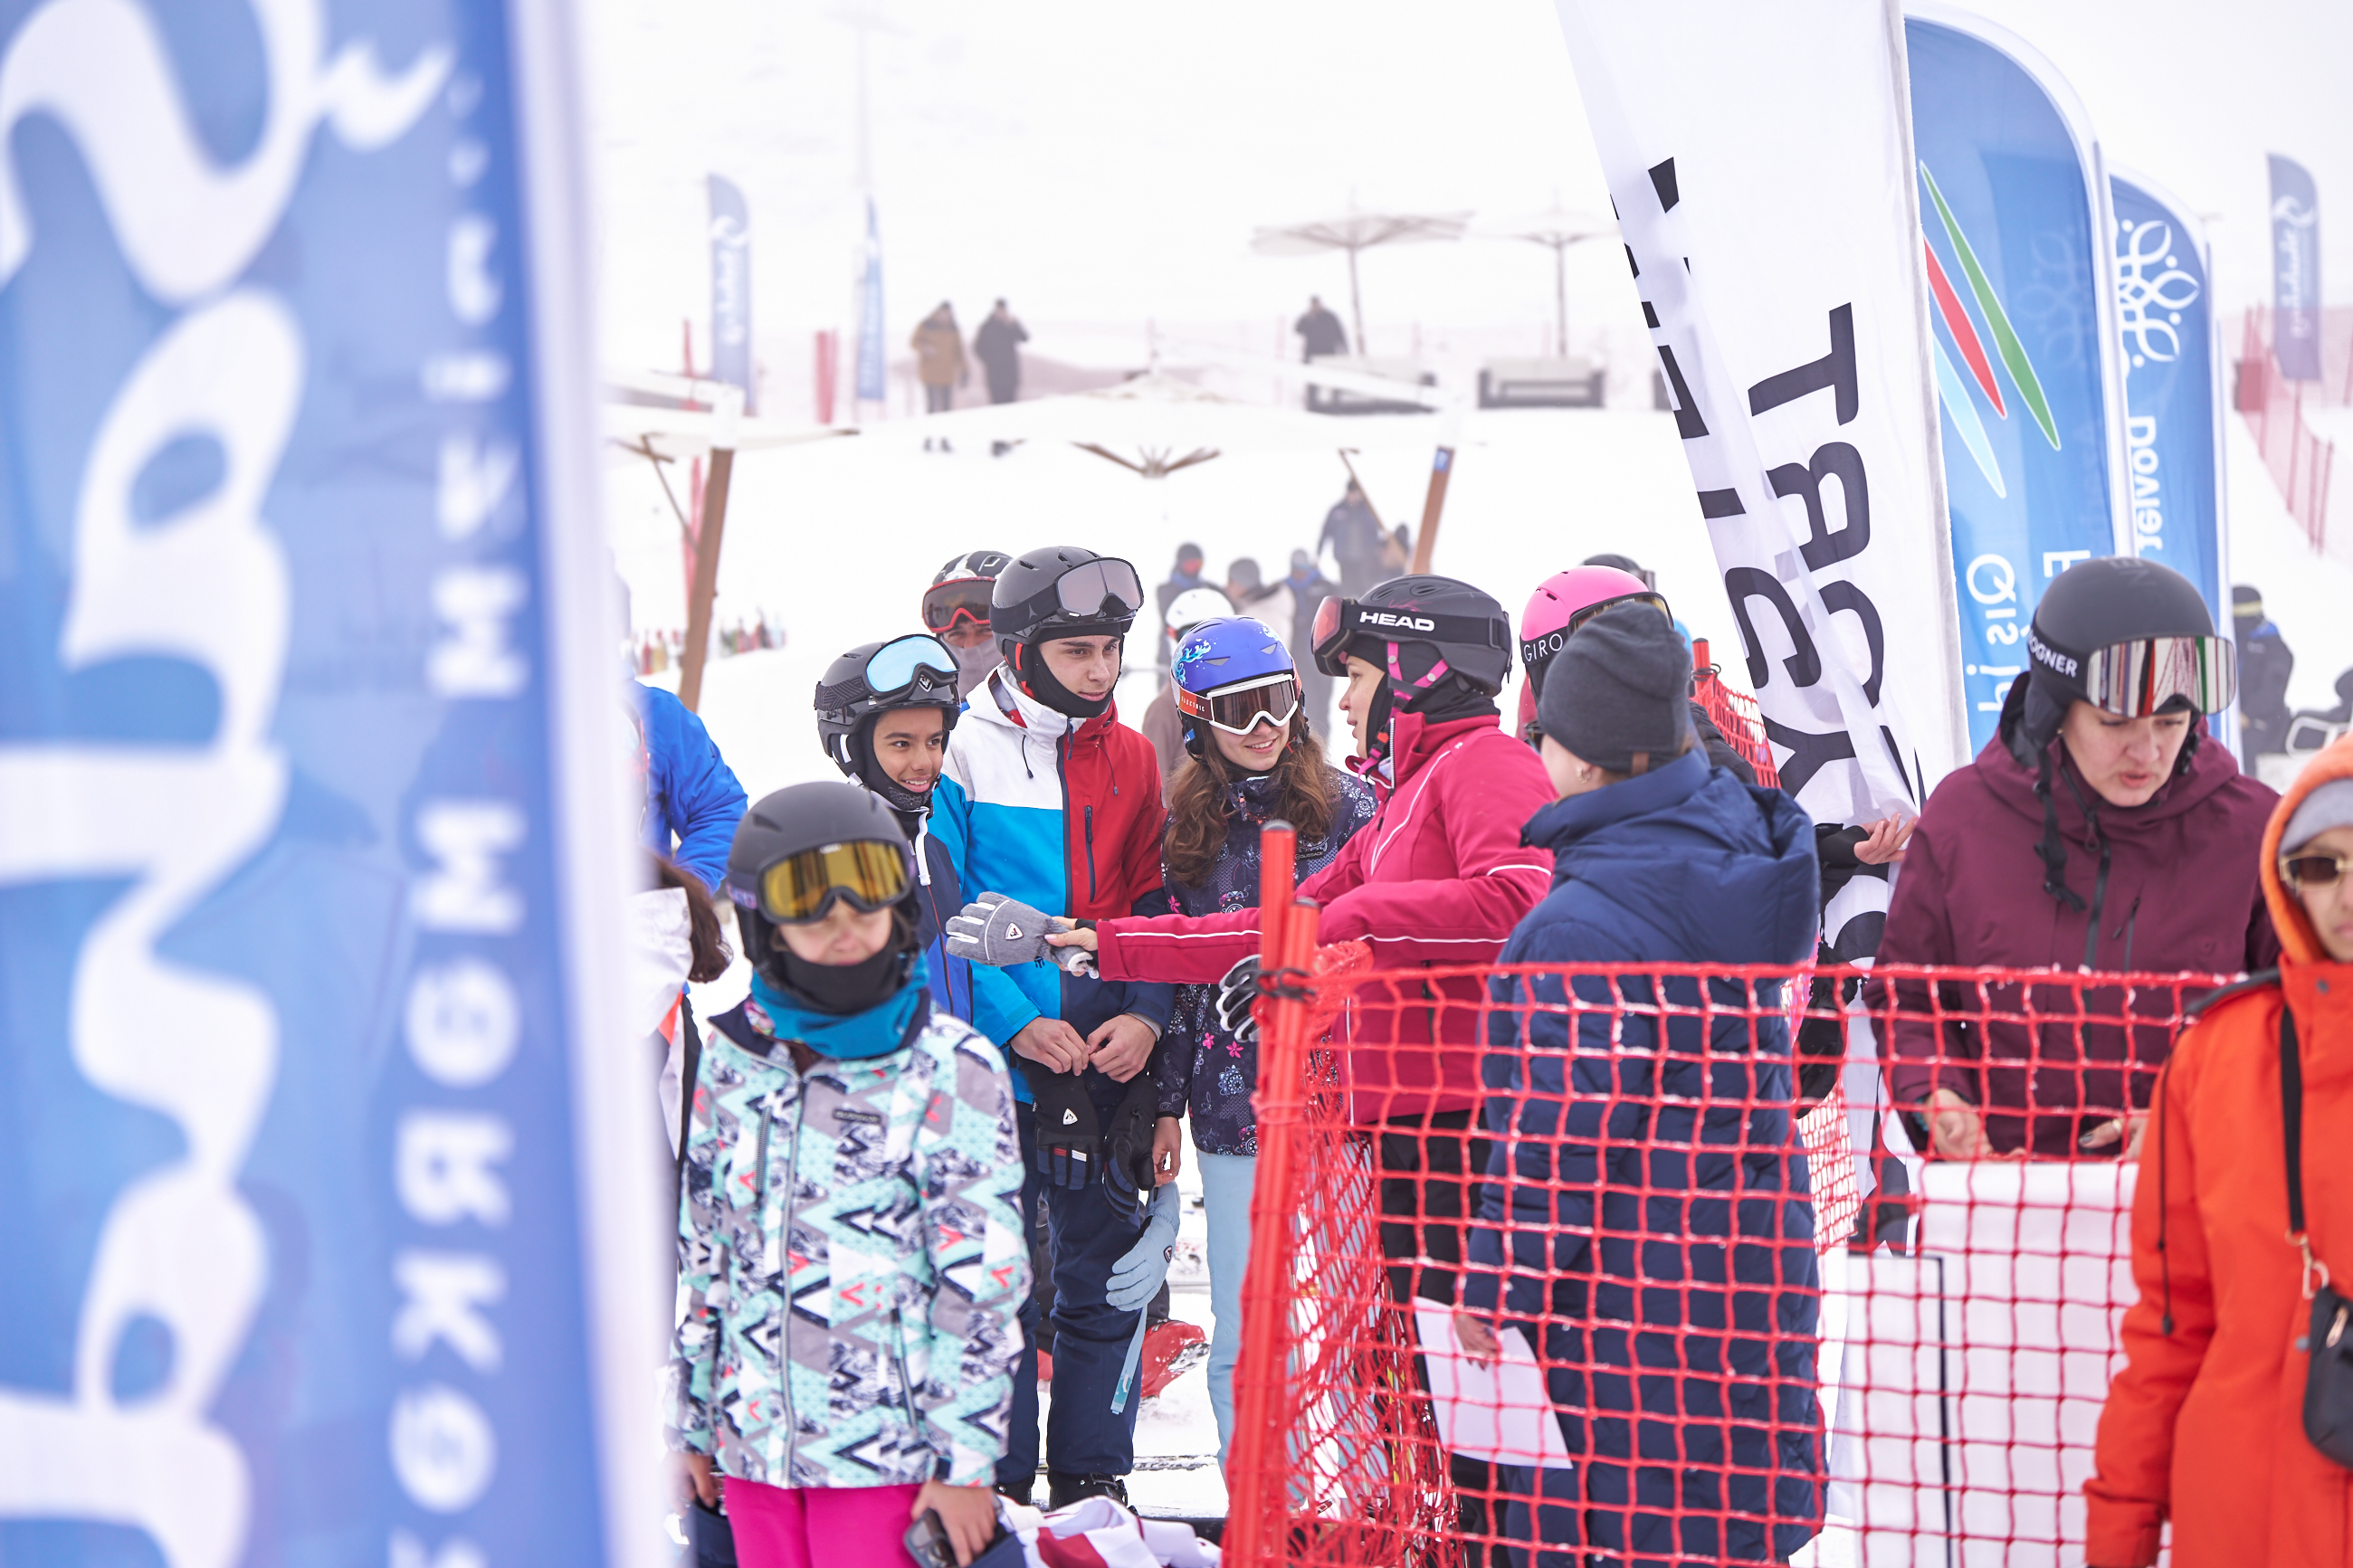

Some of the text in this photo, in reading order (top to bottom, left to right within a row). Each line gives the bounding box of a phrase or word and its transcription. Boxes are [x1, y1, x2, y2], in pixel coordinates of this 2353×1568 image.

[1359, 611, 1435, 632] HEAD
[1523, 632, 1564, 662] GIRO
[1180, 696, 1205, 712] ELECTRIC
